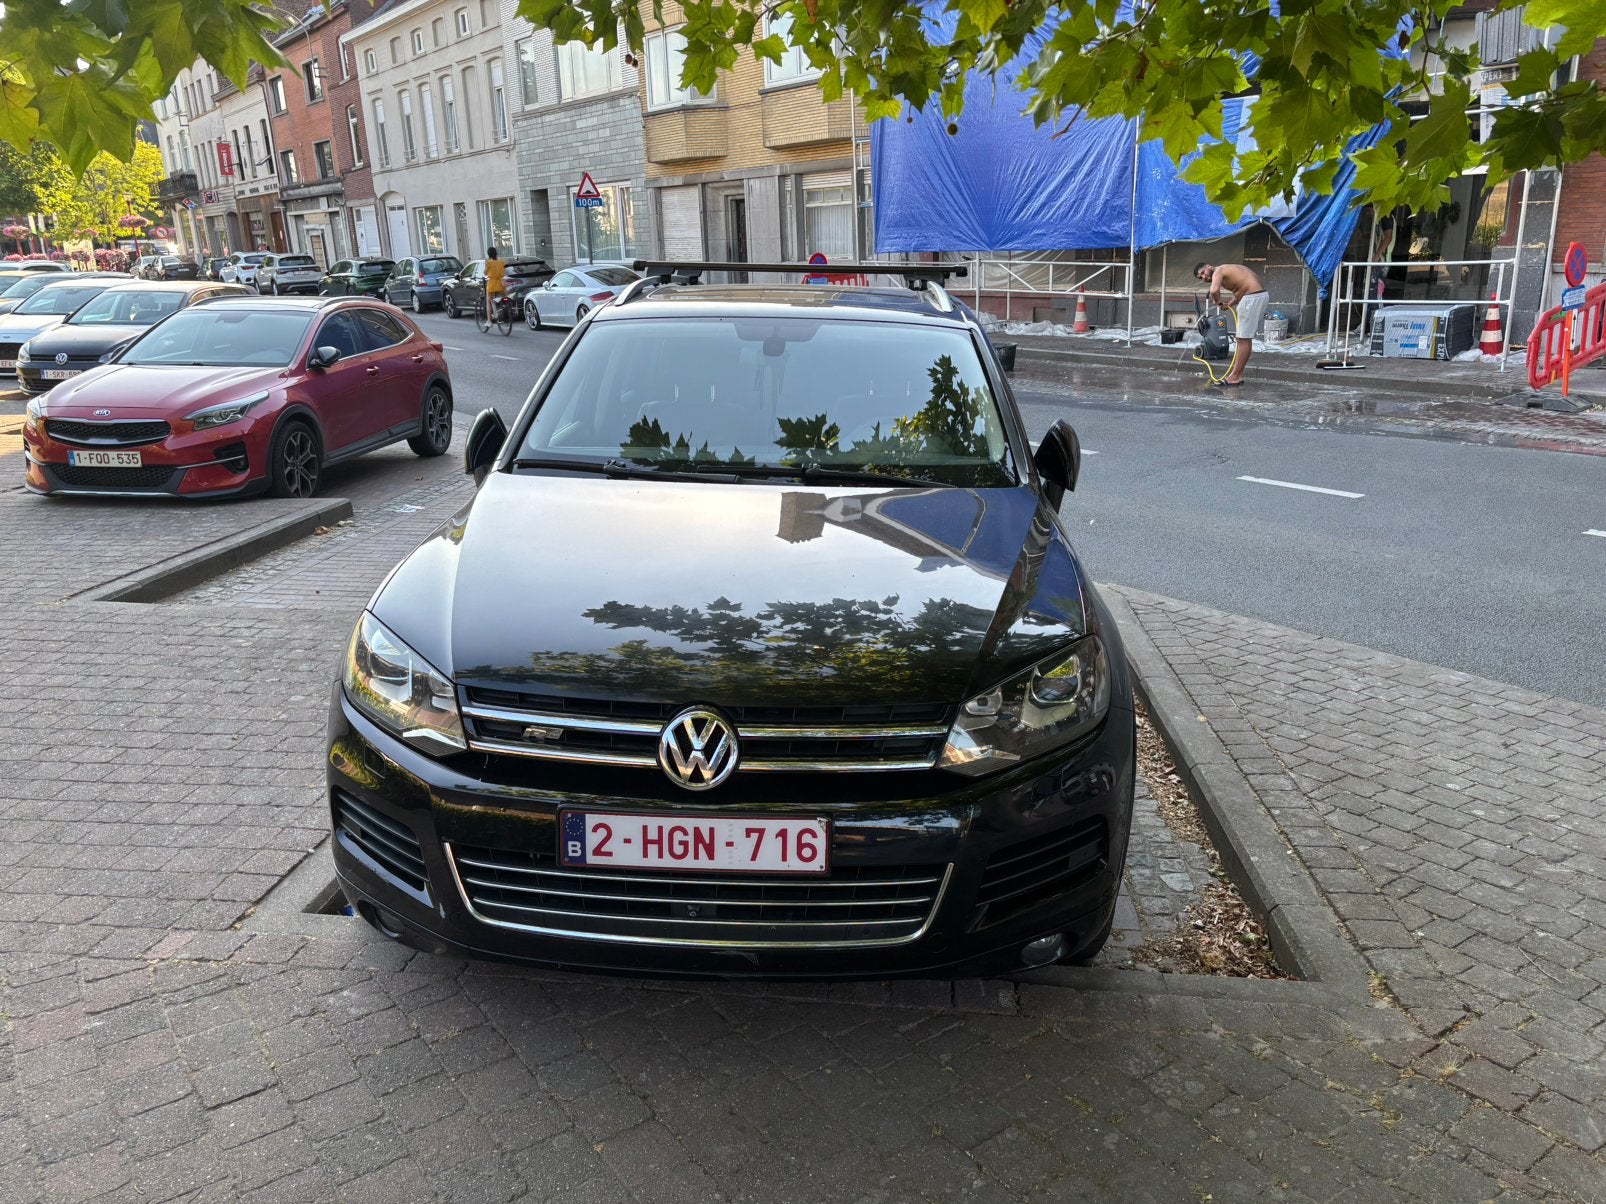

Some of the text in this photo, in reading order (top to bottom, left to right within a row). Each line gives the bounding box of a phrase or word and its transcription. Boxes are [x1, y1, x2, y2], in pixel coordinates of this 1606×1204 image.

[579, 198, 600, 206] 100m
[567, 841, 582, 857] B
[591, 822, 818, 863] 2-HGN-716
